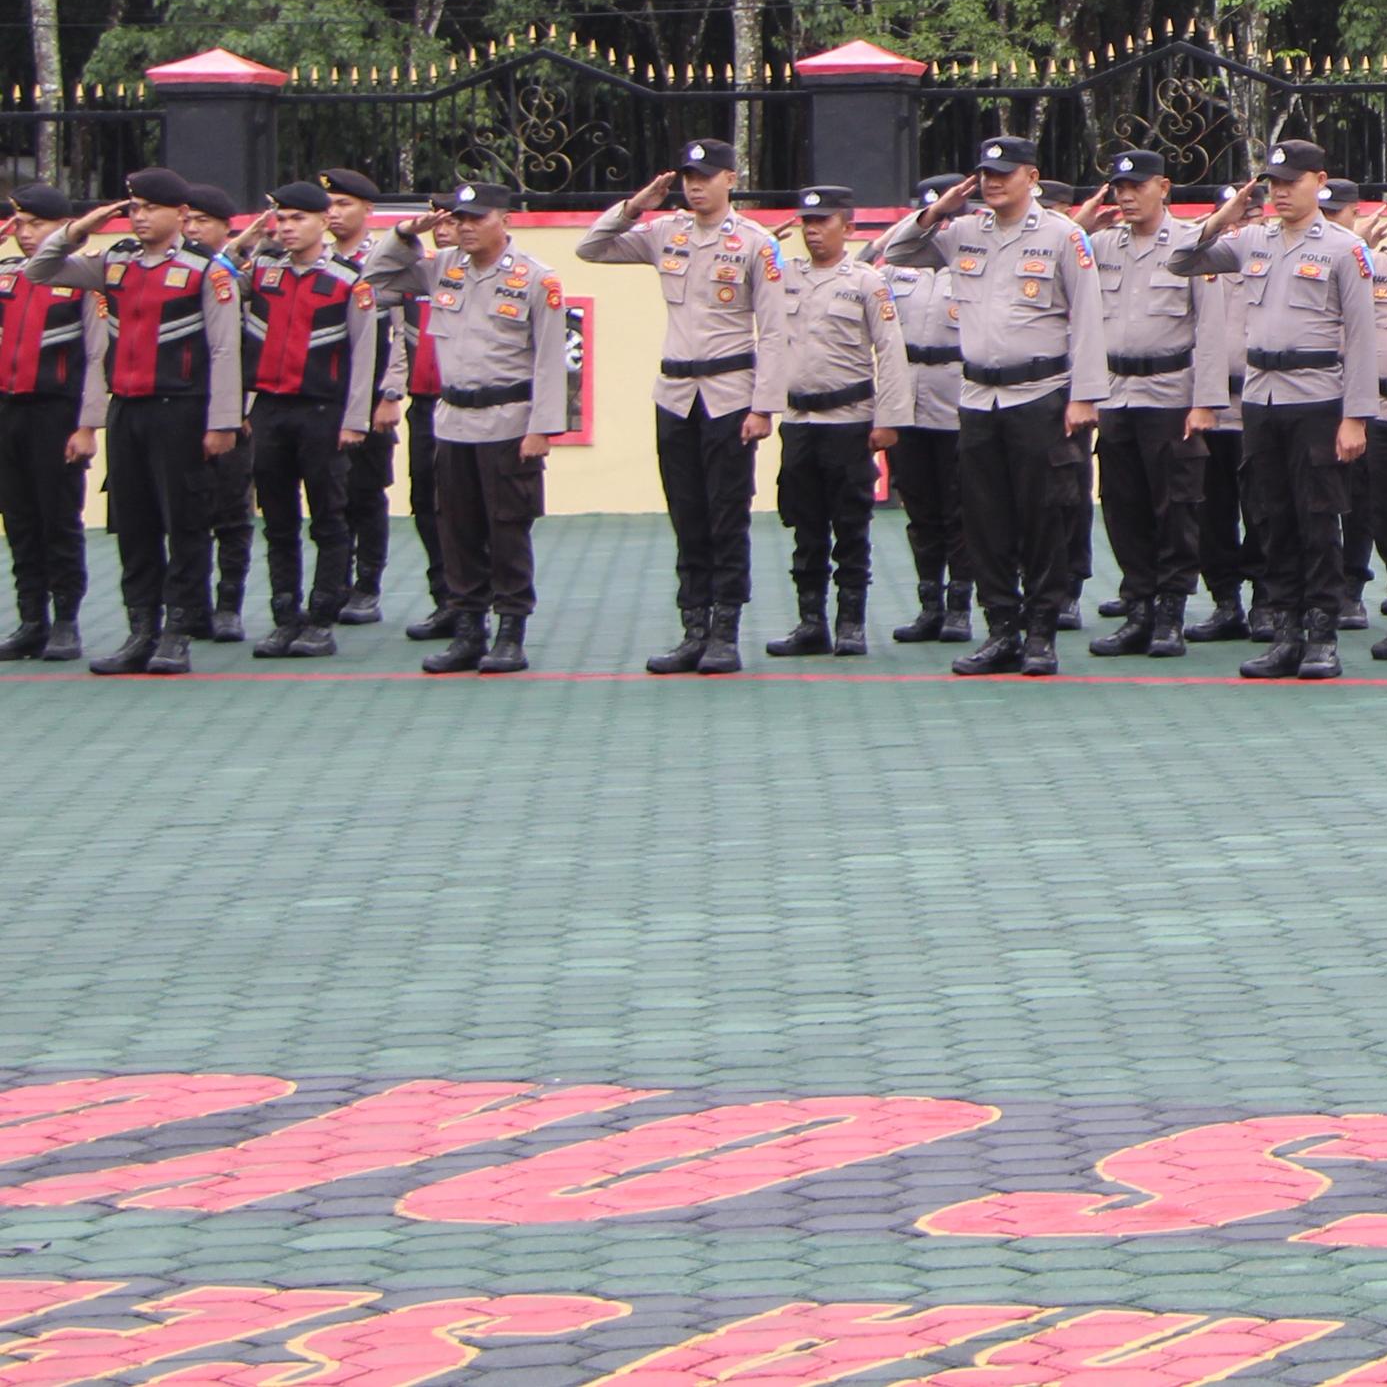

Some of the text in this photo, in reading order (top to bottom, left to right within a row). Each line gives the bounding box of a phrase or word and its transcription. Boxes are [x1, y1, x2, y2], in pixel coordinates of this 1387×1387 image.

[714, 253, 746, 264] POLRI
[1023, 249, 1053, 257] POLRI
[1300, 252, 1332, 263] POLRI
